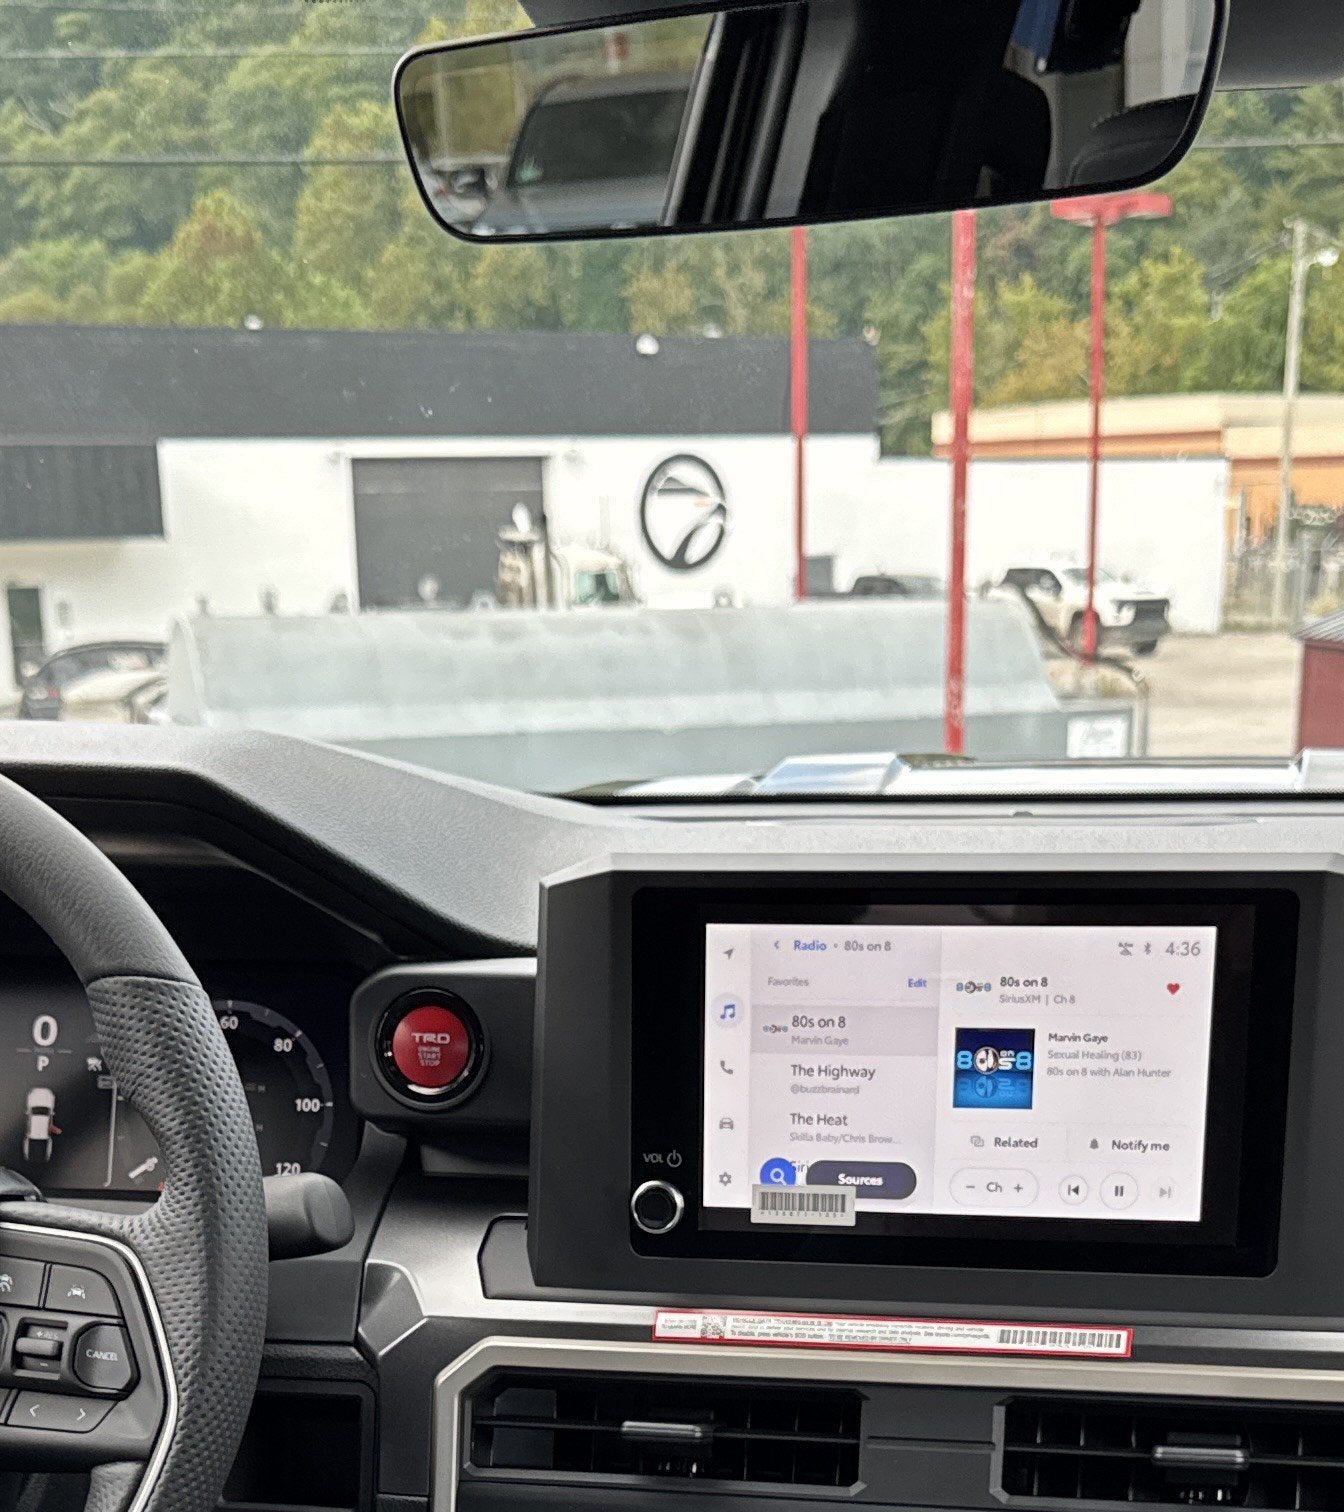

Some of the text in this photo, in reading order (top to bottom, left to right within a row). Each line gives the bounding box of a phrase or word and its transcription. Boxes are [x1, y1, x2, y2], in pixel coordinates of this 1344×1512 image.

[793, 940, 892, 952] Radio 80s on 8
[1165, 940, 1201, 957] 4:36
[768, 976, 809, 987] Favorites
[907, 978, 928, 988] Edit
[999, 976, 1020, 988] 80s
[1023, 979, 1038, 988] on
[1040, 976, 1048, 988] 8
[999, 994, 1076, 1004] SiriusXM Ch 8
[219, 1015, 239, 1030] 60
[792, 1015, 846, 1028] 80s on 8
[31, 1014, 58, 1047] 0
[273, 1038, 293, 1052] 80
[411, 1032, 451, 1045] TRD
[791, 1036, 849, 1048] Marvin Gaye
[1048, 1033, 1108, 1046] Marvin Gaye
[1047, 1050, 1142, 1062] Sexual Healing (83)
[36, 1055, 49, 1072] P
[791, 1064, 876, 1081] The Highway
[1046, 1067, 1172, 1079] 80s on 8 with Alan Hunter
[295, 1098, 321, 1113] 100
[790, 1112, 848, 1126] The Heat
[993, 1137, 1038, 1149] Related
[1111, 1139, 1170, 1154] Notify me
[642, 1153, 664, 1163] VOL
[275, 1162, 301, 1175] 120
[837, 1172, 884, 1186] Sources
[986, 1182, 1002, 1194] Ch
[85, 1349, 118, 1362] CANCEL
